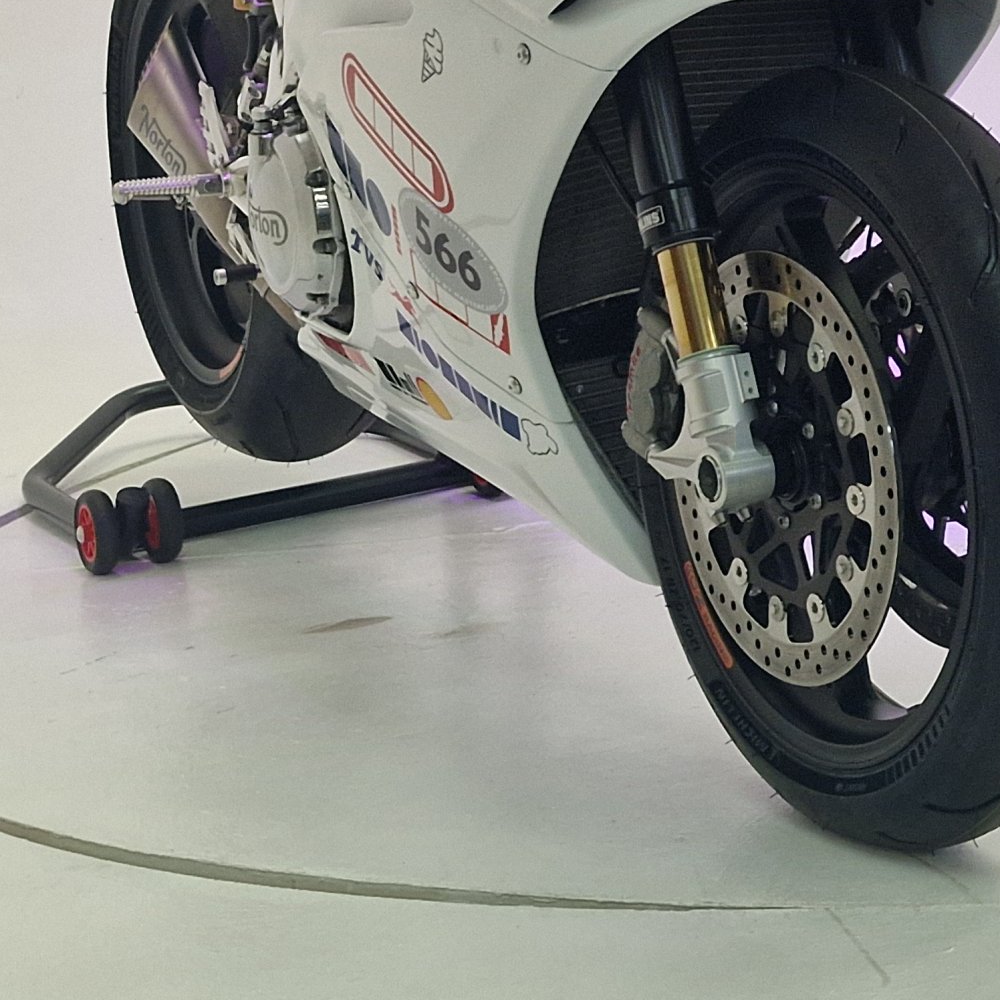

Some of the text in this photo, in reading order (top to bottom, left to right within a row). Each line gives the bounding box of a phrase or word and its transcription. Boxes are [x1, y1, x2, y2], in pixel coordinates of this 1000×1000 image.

[140, 103, 187, 175] Norton
[248, 200, 288, 246] orton
[351, 227, 384, 282] TVS
[416, 206, 482, 292] 566
